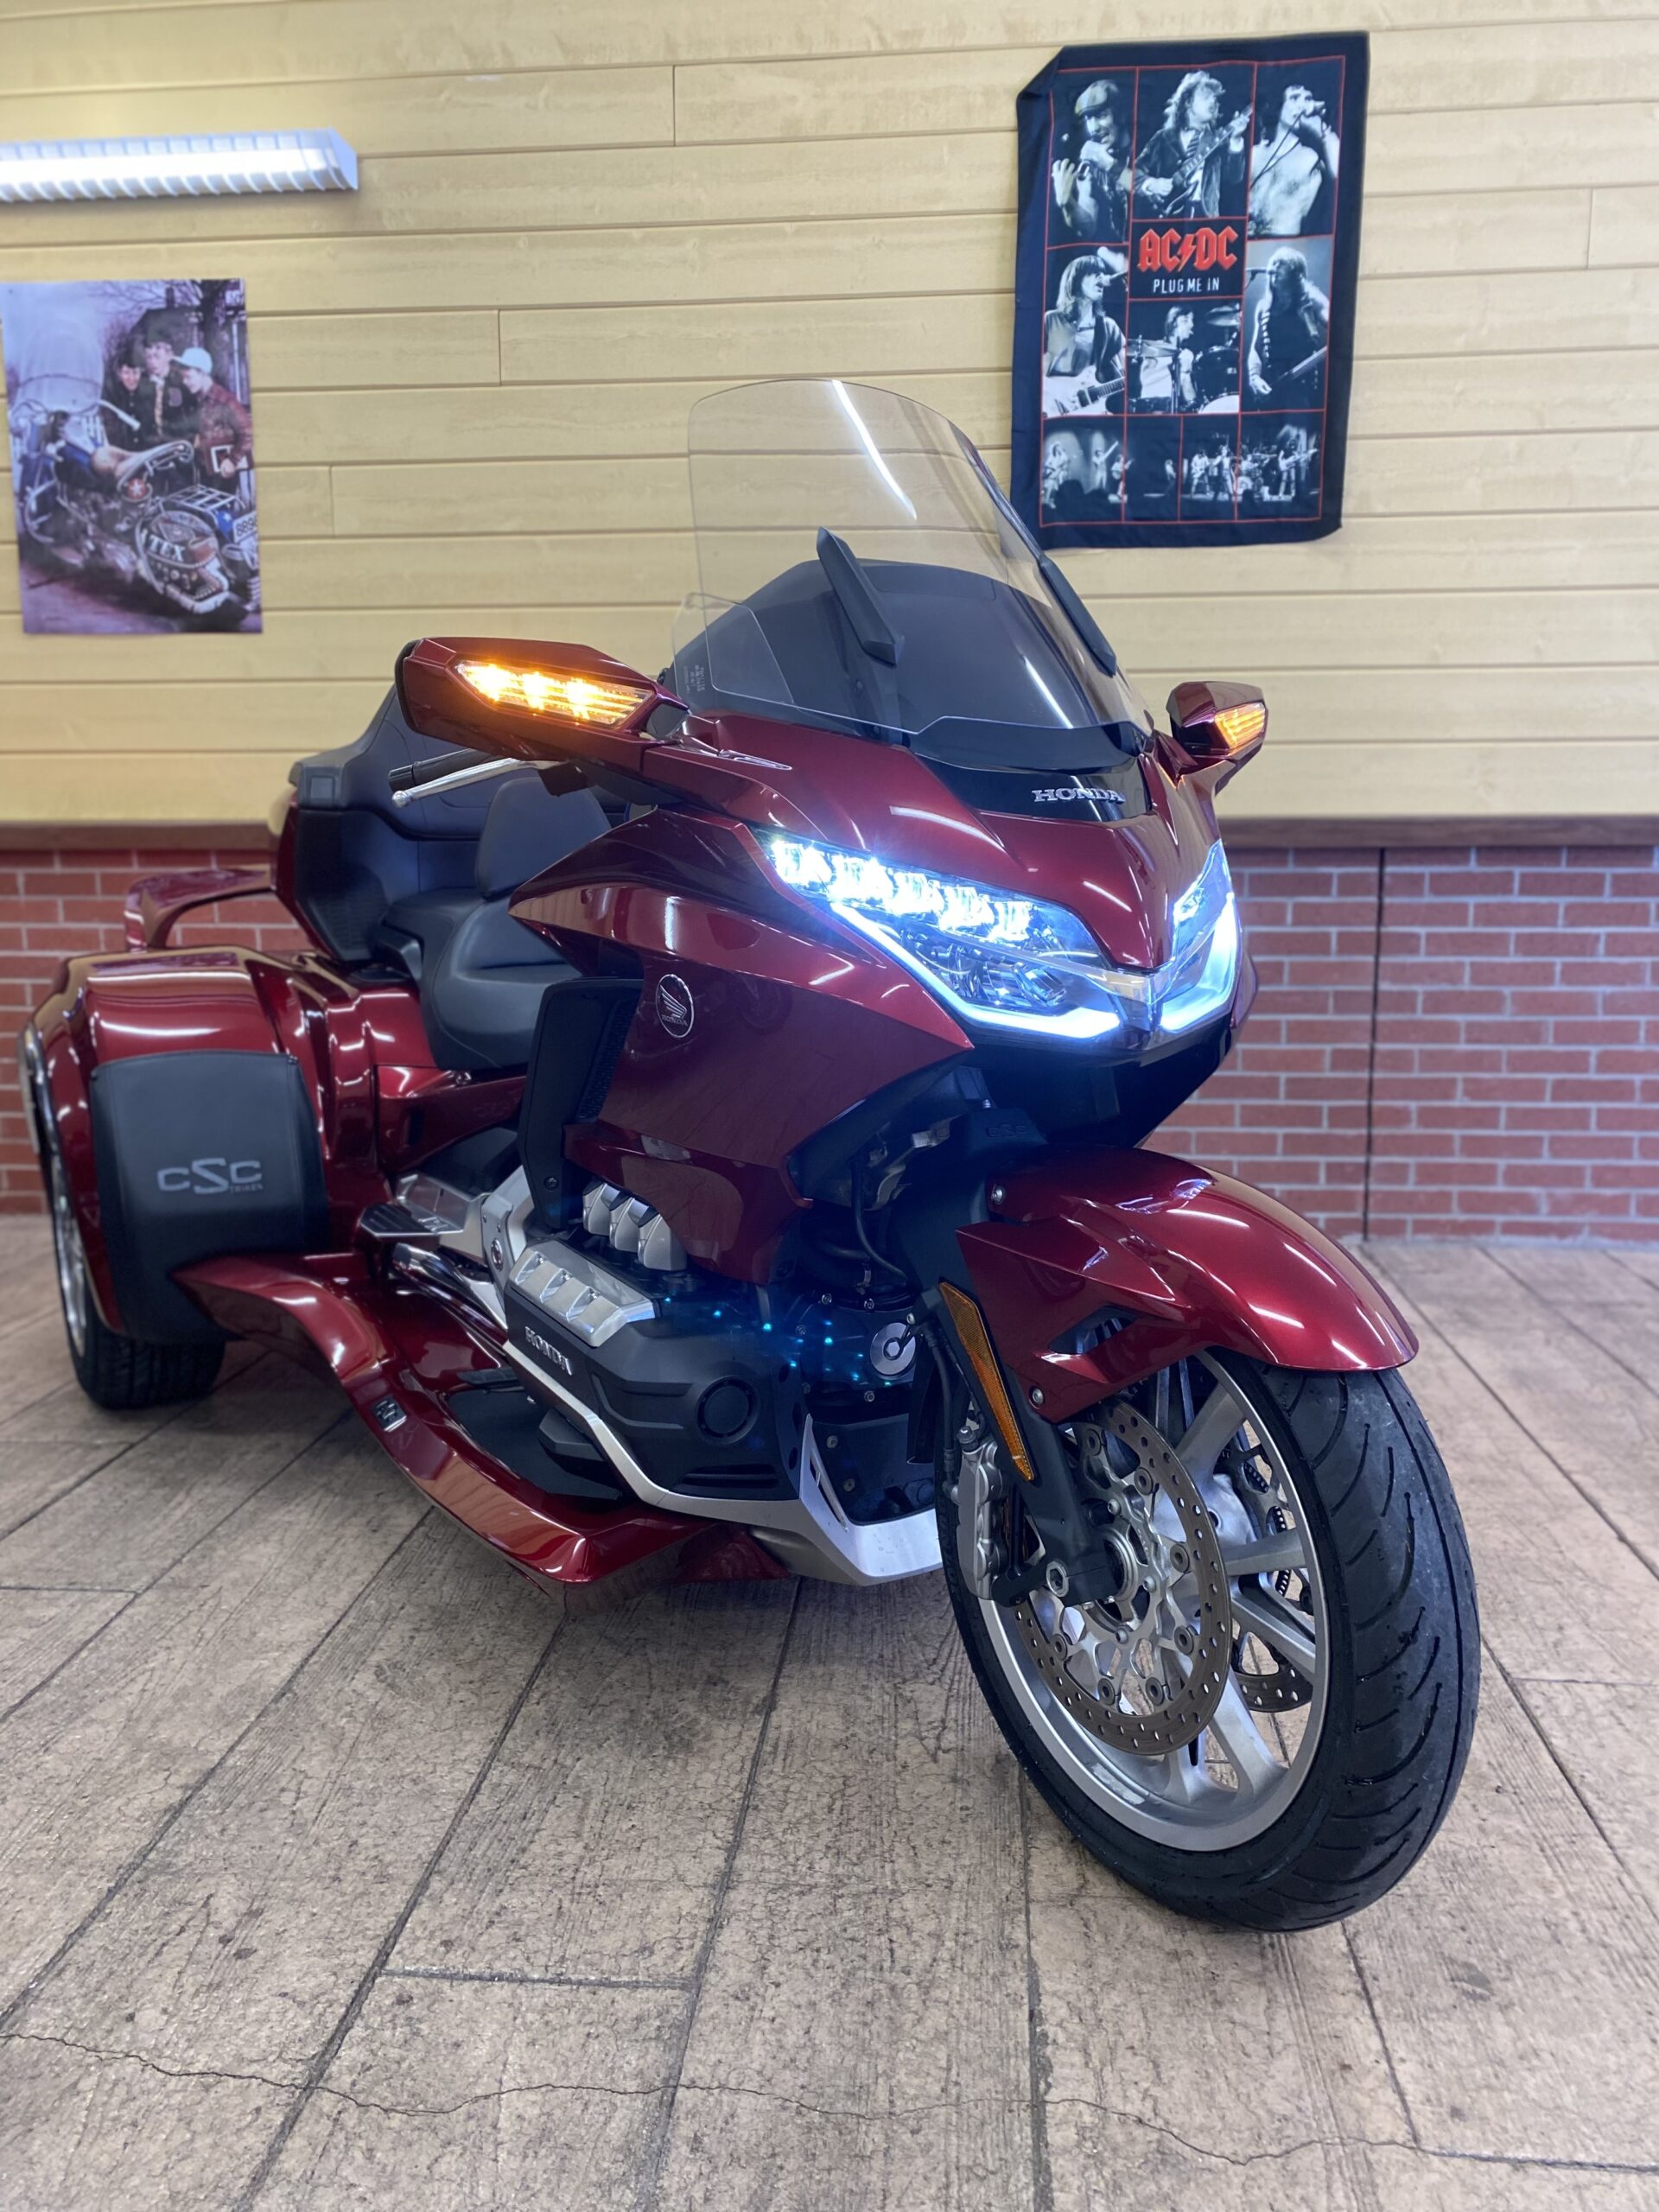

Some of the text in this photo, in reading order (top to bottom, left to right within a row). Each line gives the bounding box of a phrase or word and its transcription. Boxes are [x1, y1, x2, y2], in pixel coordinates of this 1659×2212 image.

[1153, 276, 1220, 294] PLUG ME IN
[149, 535, 185, 562] TEX
[1032, 787, 1125, 802] HONDA
[661, 1014, 689, 1027] HONDA
[524, 1325, 572, 1376] HONDA
